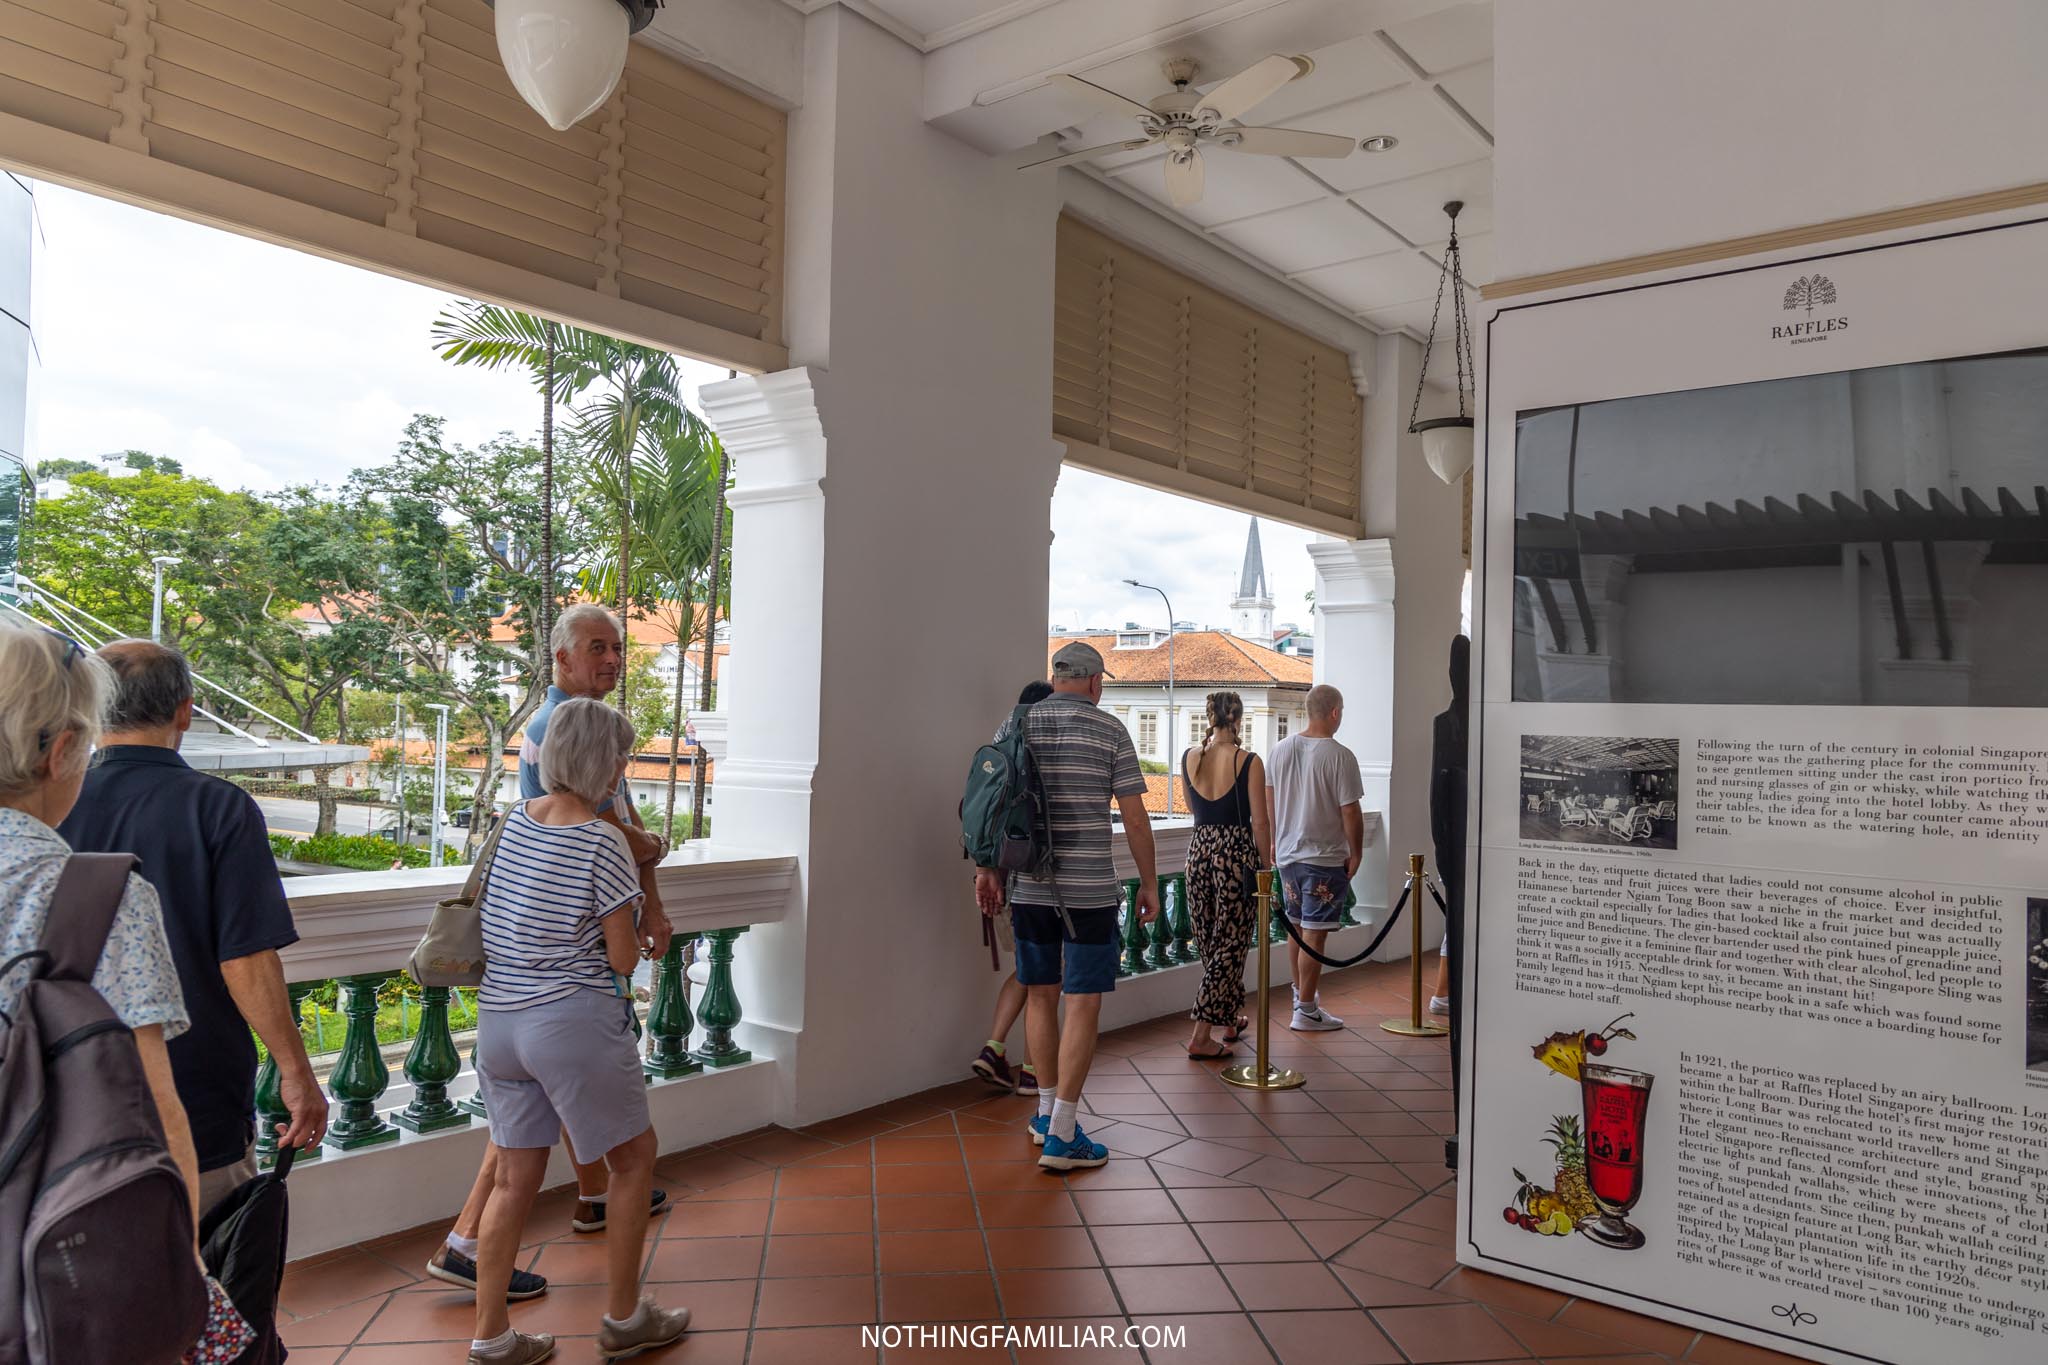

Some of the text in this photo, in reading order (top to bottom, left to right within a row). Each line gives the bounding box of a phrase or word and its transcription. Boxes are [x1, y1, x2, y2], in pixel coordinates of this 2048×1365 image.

[1772, 317, 1848, 339] RAFFLES
[1791, 335, 1828, 345] SINGAPORE
[1696, 751, 1752, 764] Singapore
[1784, 754, 1802, 763] the
[1807, 755, 1865, 768] gathering
[1870, 756, 1903, 769] place
[1909, 757, 1927, 768] for
[1932, 758, 1953, 768] the
[1958, 761, 2039, 774] community.
[1697, 739, 1751, 752] Following
[1756, 740, 1774, 750] the
[1779, 743, 1805, 751] turn
[1809, 742, 1821, 751] of
[1826, 742, 1846, 752] the
[1850, 745, 1899, 756] century
[1904, 745, 1917, 754] in
[1922, 745, 1974, 756] colonial
[1696, 776, 1717, 785] and
[1721, 778, 1764, 790] nursing
[1768, 778, 1808, 790] glasses
[1813, 780, 1825, 790] of
[1829, 782, 1848, 793] gin
[1872, 783, 1918, 797] whisky,
[1924, 785, 1960, 796] while
[1965, 787, 2029, 802] watching
[1695, 814, 1724, 822] came
[1730, 815, 1742, 823] to
[1748, 814, 1761, 824] be
[1767, 816, 1806, 827] known
[1832, 819, 1852, 830] the
[1859, 823, 1915, 836] watering
[1921, 824, 1954, 838] hole,
[1986, 828, 2040, 844] identity
[1695, 826, 1731, 835] retain.
[1518, 856, 2002, 906] Back in the day, etiquette dictated that ladies could not consume alcohol in public
[1518, 879, 1568, 892] Hainanese
[1572, 884, 1622, 897] bartender
[1626, 889, 1660, 902] Ngiam
[1666, 893, 1692, 907] Tong
[1697, 896, 1725, 907] Boon
[1730, 902, 1752, 910] saw
[1769, 904, 1801, 914] niche
[1807, 907, 1818, 916] in
[1824, 908, 1843, 918] the
[1849, 912, 1893, 923] market
[1899, 916, 1924, 926] and
[1930, 917, 1981, 932] decided
[1988, 925, 2003, 934] to
[1517, 902, 2001, 963] infused with gin and liqueurs. The gin-based cocktail also contained pineapple juice,
[1516, 947, 1538, 958] born
[1555, 952, 1589, 964] Raffles
[1592, 957, 1601, 966] in
[1607, 958, 1634, 970] 1915.
[1638, 962, 1684, 976] Needless
[1688, 970, 1699, 978] to
[1702, 973, 1723, 984] say,
[1727, 974, 1735, 983] it
[1739, 974, 1783, 989] became
[1806, 983, 1847, 997] instant
[1853, 988, 1874, 1000] hit!
[1680, 1051, 1691, 1061] In
[1695, 1053, 1727, 1069] 1921,
[1730, 1059, 1748, 1070] the
[1751, 1065, 1794, 1078] portico
[1797, 1073, 1820, 1082] was
[1824, 1077, 1877, 1091] replaced
[1881, 1083, 1897, 1098] by
[1901, 1089, 1917, 1098] an
[1921, 1091, 1947, 1106] airy
[1951, 1094, 2017, 1114] ballroom.
[1679, 1113, 1700, 1125] The
[1706, 1119, 1746, 1134] elegant
[1754, 1129, 1854, 1154] neo-Renaissance
[1861, 1149, 1939, 1170] architecture
[1947, 1165, 1972, 1176] and
[1980, 1172, 2021, 1185] grand
[1678, 1138, 2036, 1216] electric lights and fans. Alongside these innovations, the
[1677, 1211, 1979, 1289] inspired by Malayan plantation life in the 1920s.
[1676, 1250, 2004, 1336] right where it was created more than 100 years ago.
